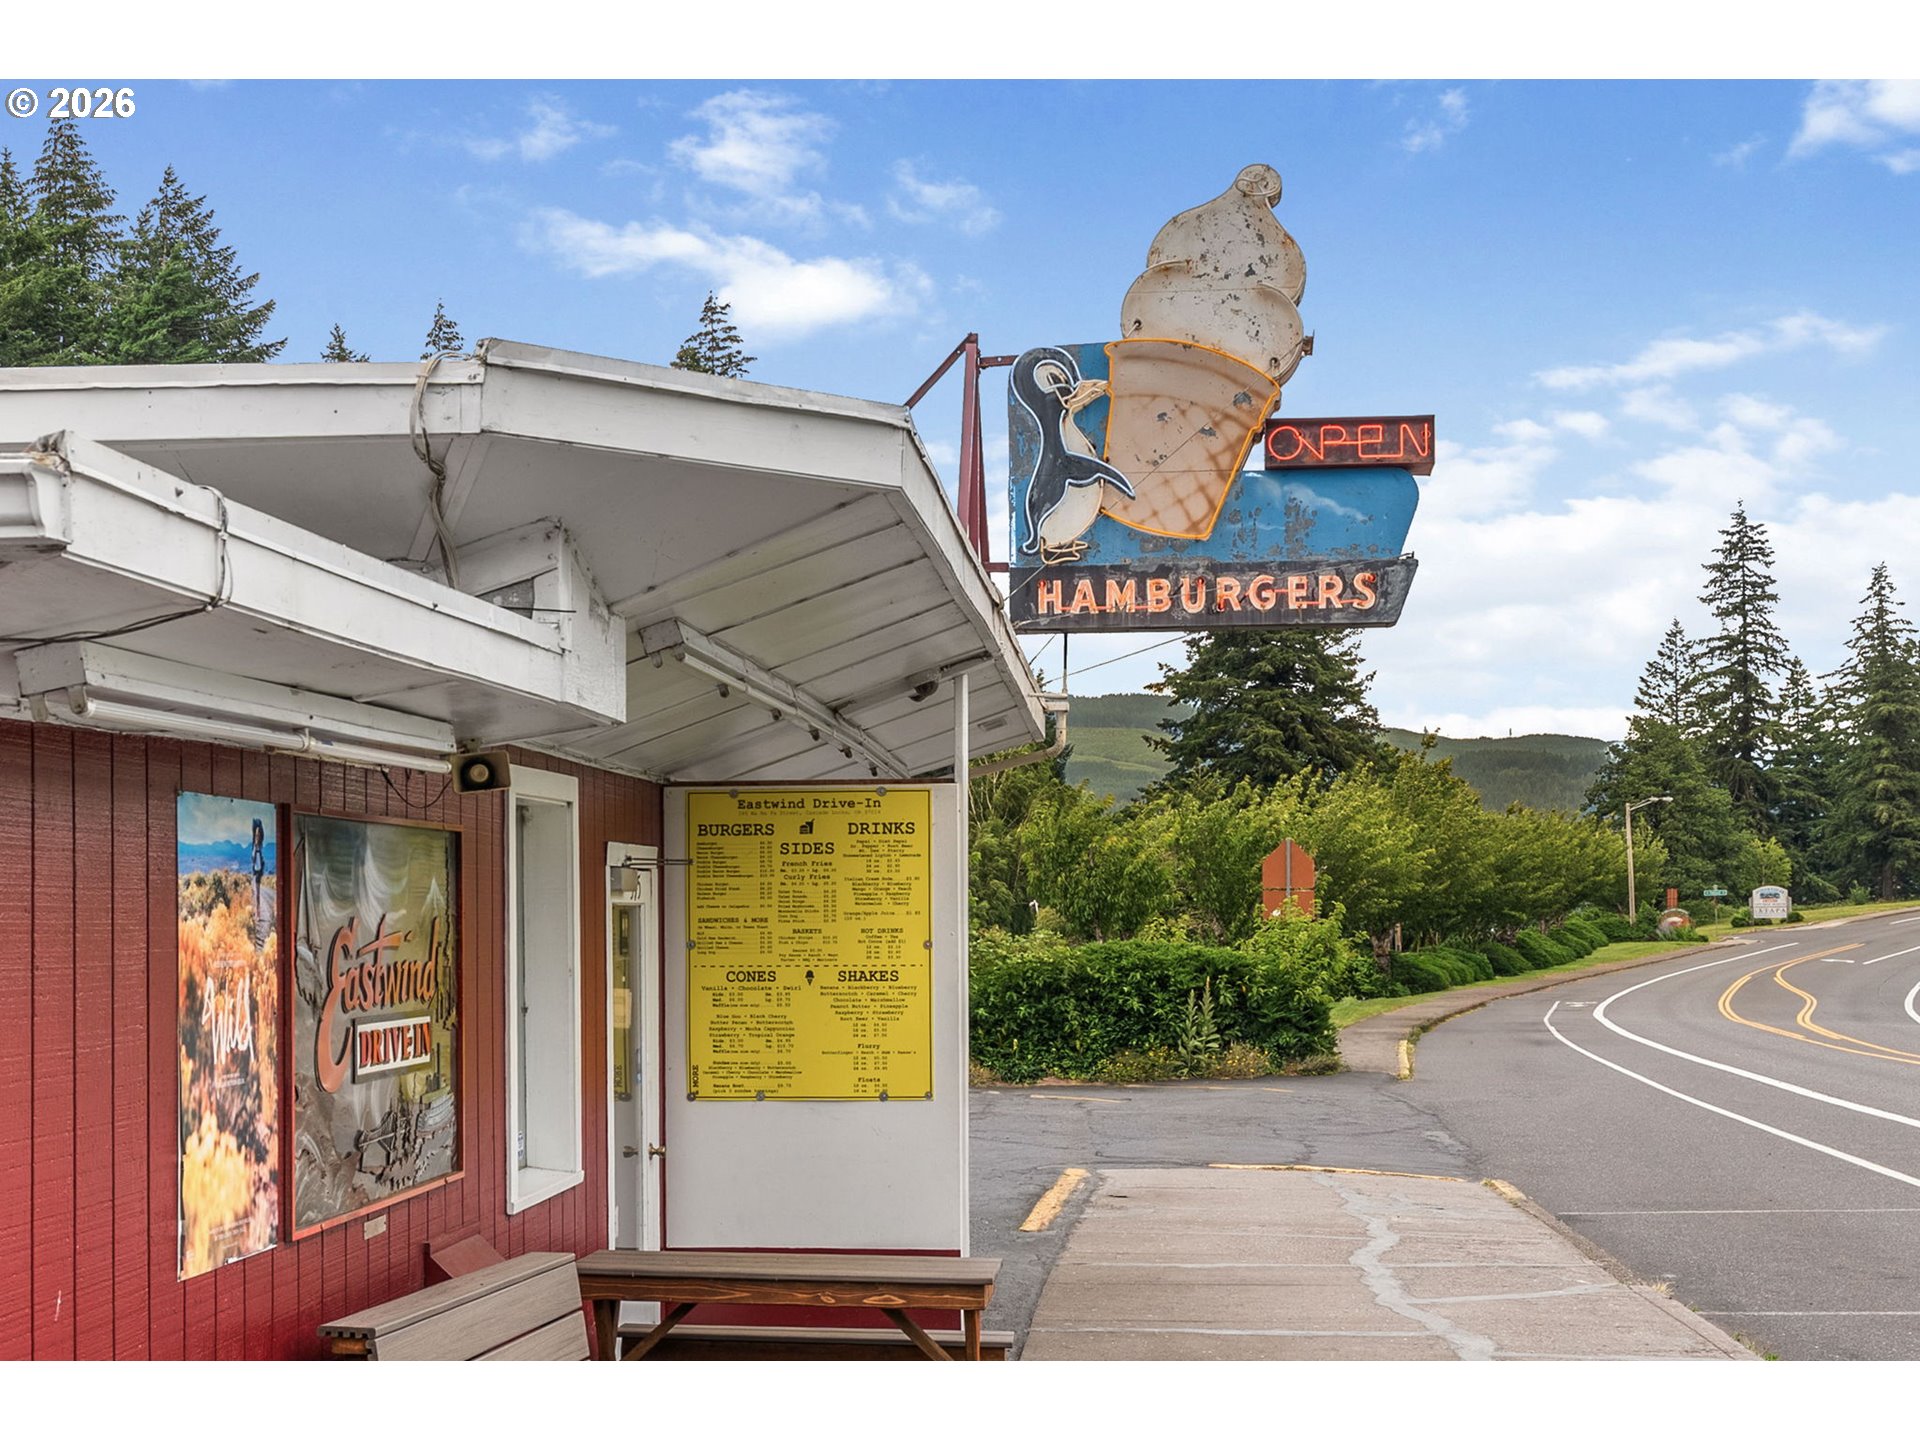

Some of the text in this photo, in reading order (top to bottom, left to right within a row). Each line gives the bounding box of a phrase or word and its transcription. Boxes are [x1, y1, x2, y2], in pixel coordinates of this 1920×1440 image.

[1267, 422, 1430, 461] OPEN
[1037, 572, 1377, 615] HAMBURGERS
[737, 798, 881, 810] Eastwind Drive-In
[698, 823, 775, 836] BURGERS
[848, 822, 916, 835] DRINKS
[780, 842, 835, 855] SIDES
[726, 970, 777, 982] CONES
[838, 970, 899, 982] SHAKES
[315, 912, 441, 1094] Eastwind
[202, 968, 255, 1065] Wild
